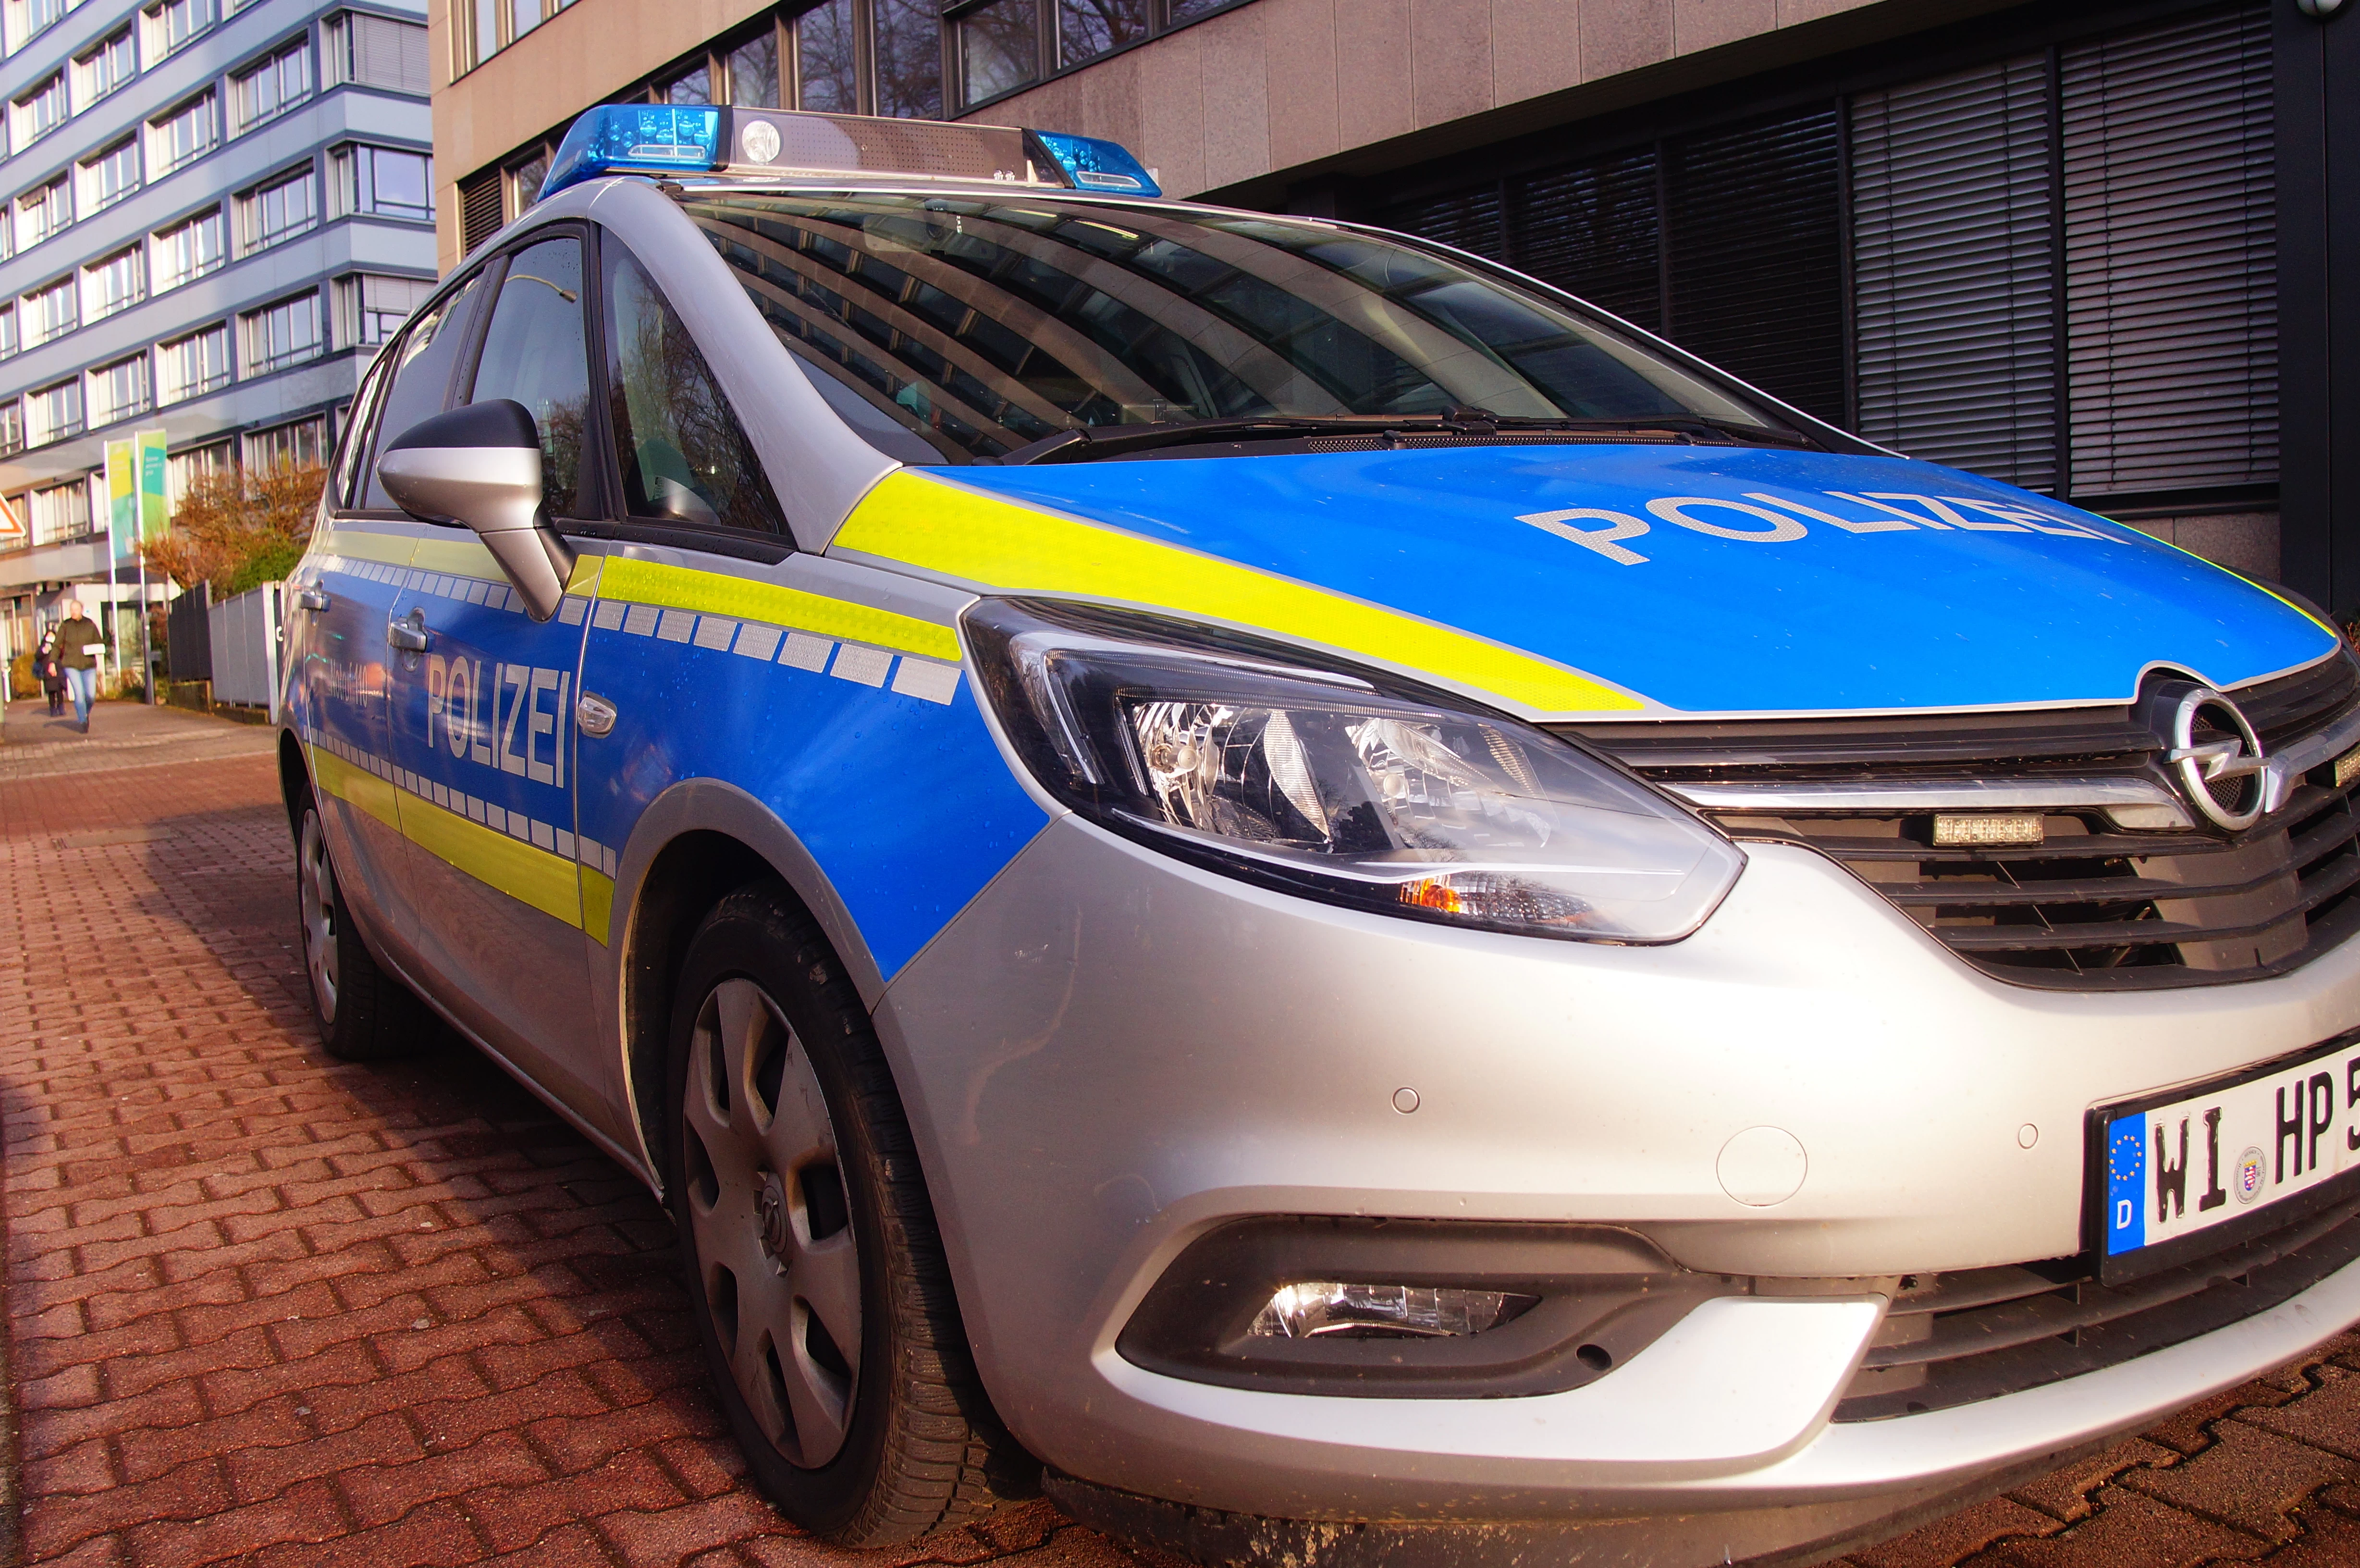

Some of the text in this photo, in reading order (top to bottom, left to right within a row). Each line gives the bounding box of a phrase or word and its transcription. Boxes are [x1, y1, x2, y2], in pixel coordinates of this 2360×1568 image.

[1514, 491, 2131, 566] POLIZEI
[330, 658, 368, 708] Notruf 110
[428, 654, 570, 788] POLIZEI
[2154, 1106, 2226, 1225] WI
[2275, 1071, 2334, 1185] HP
[2117, 1199, 2132, 1230] D
